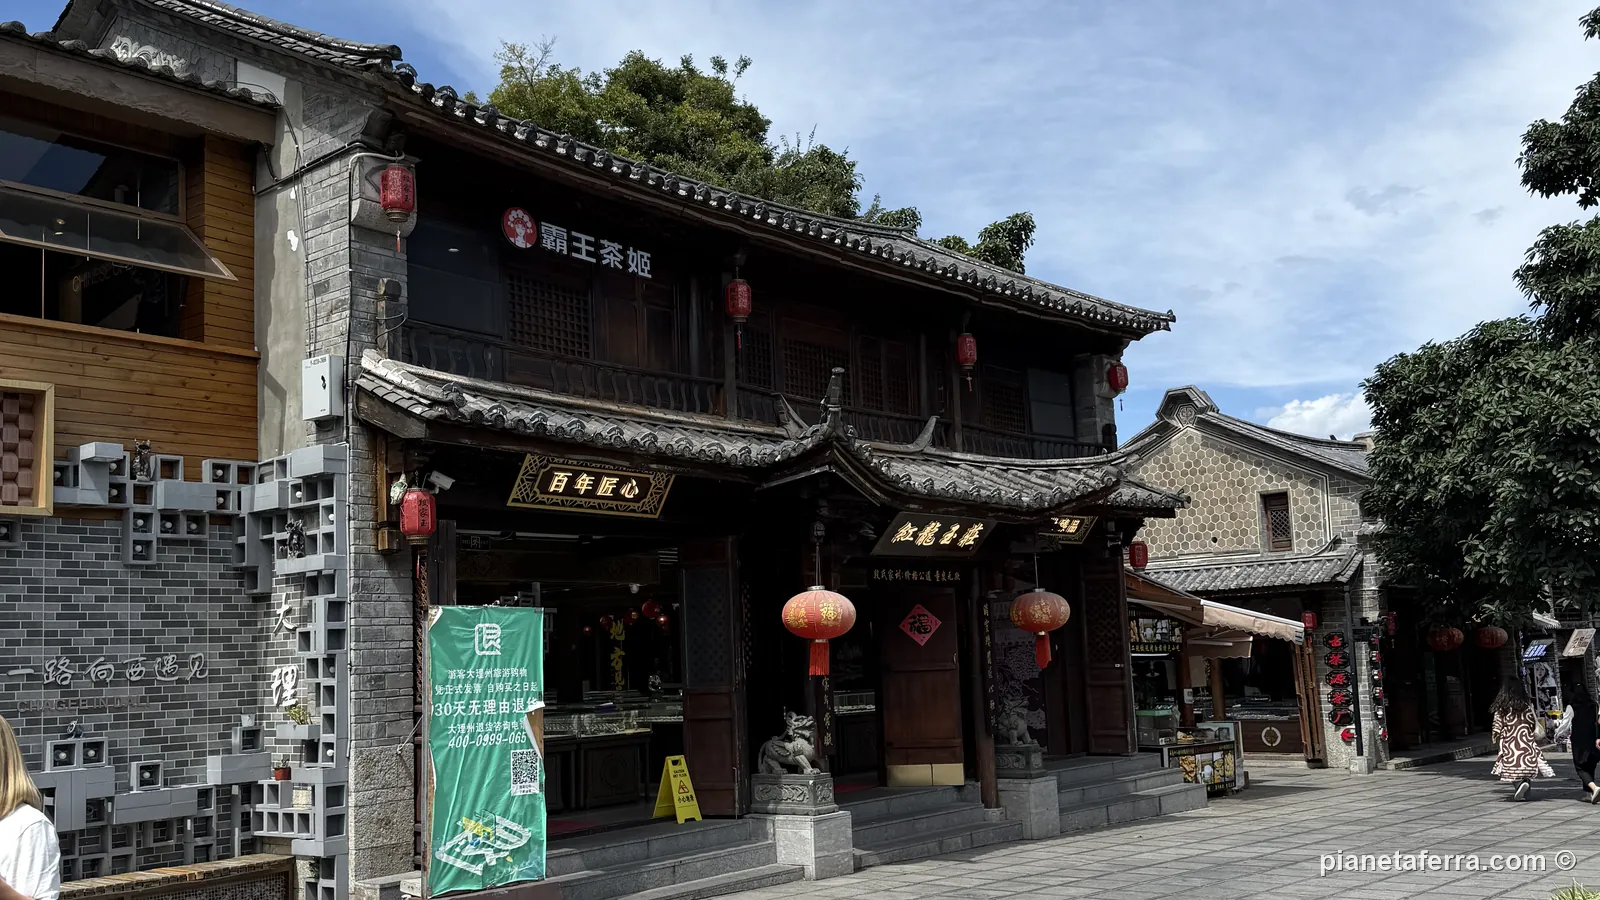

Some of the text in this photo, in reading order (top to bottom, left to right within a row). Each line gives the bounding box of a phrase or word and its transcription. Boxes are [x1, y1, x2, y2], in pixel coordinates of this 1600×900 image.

[541, 221, 652, 278] 霸王茶姬
[549, 471, 640, 499] 百年匠心
[908, 613, 932, 635] 福
[271, 593, 299, 706] 大理
[7, 653, 209, 686] 一路向西遇见
[448, 668, 528, 680] 游客大理州旅游购物
[434, 681, 538, 696] 凭正式发票 自购买之日起
[17, 695, 151, 712] CHAGEE IN DALI
